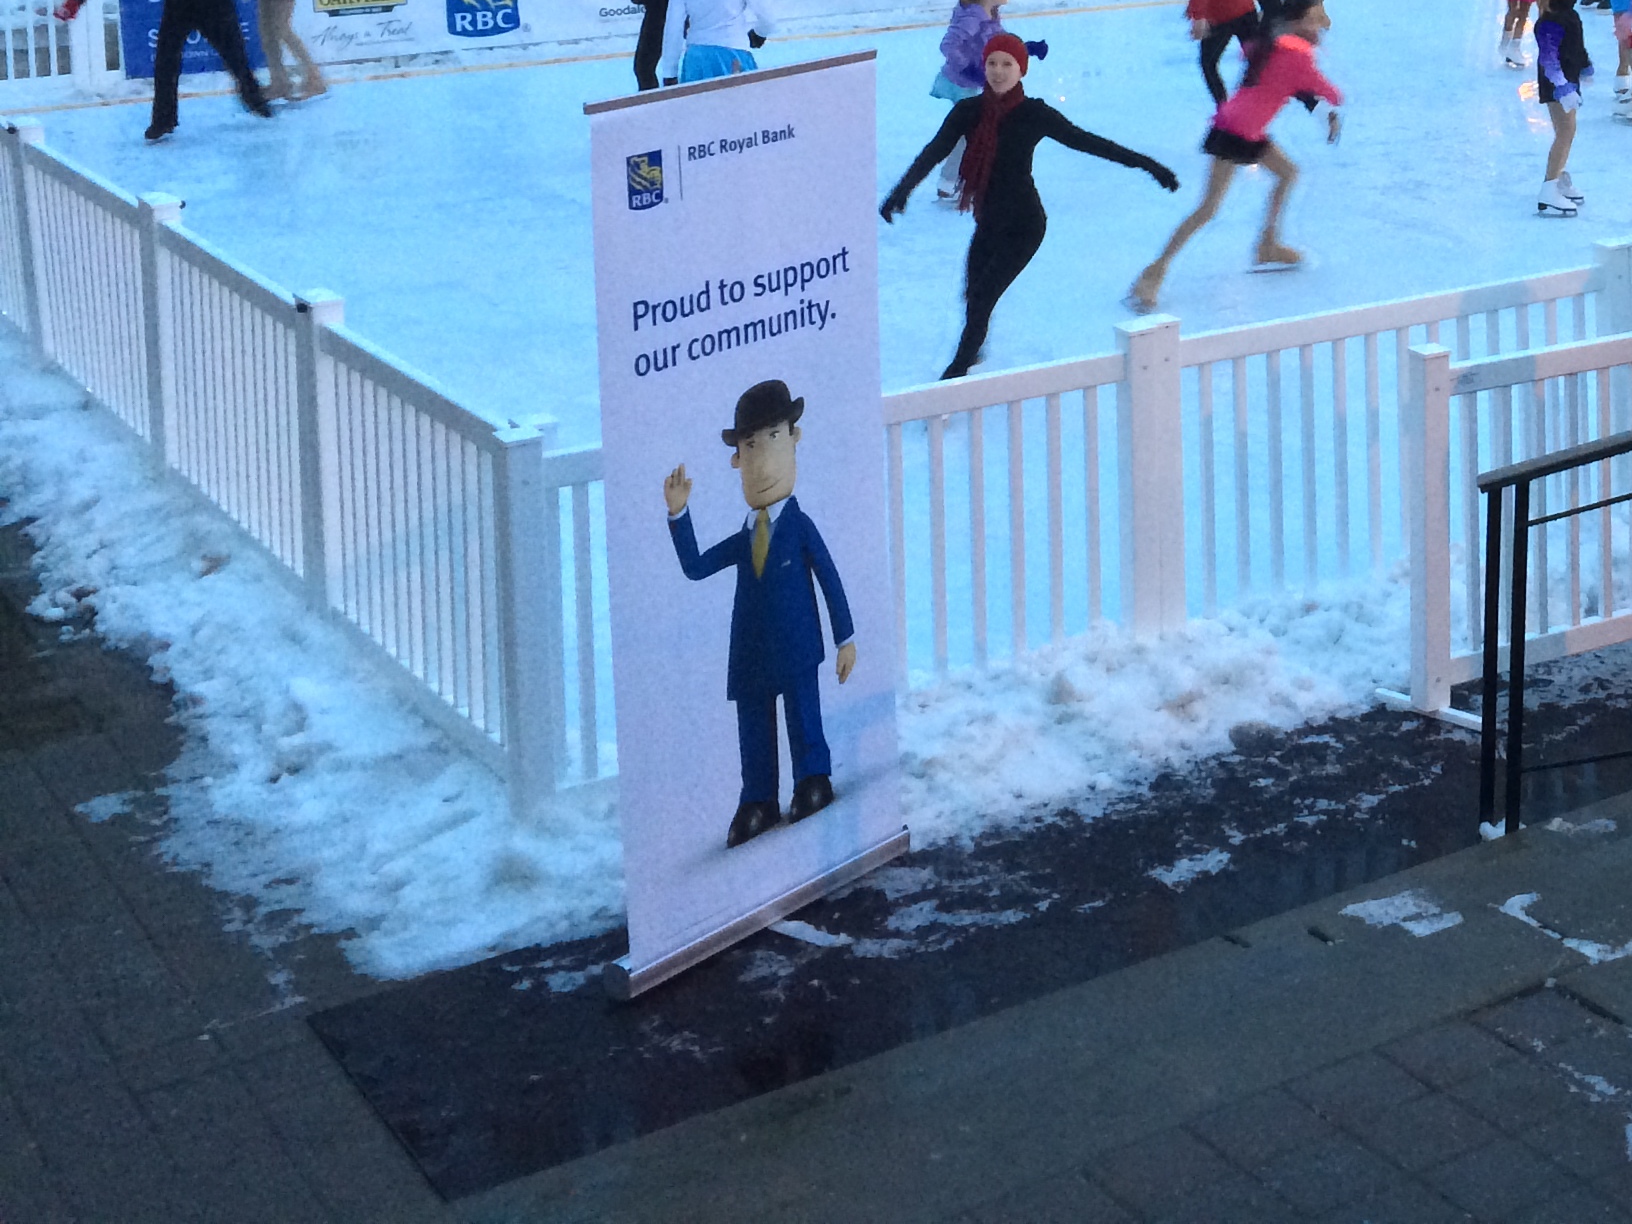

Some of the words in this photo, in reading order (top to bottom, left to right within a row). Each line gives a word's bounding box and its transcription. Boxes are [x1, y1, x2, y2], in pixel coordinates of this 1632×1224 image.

[454, 7, 517, 33] RBC
[687, 141, 716, 162] RBC
[719, 131, 758, 156] Royal
[761, 124, 796, 145] Bank
[631, 189, 662, 209] RBC
[632, 280, 711, 332] Proud
[718, 276, 745, 306] to
[753, 246, 850, 297] support
[634, 343, 681, 377] our
[687, 298, 837, 363] community.
